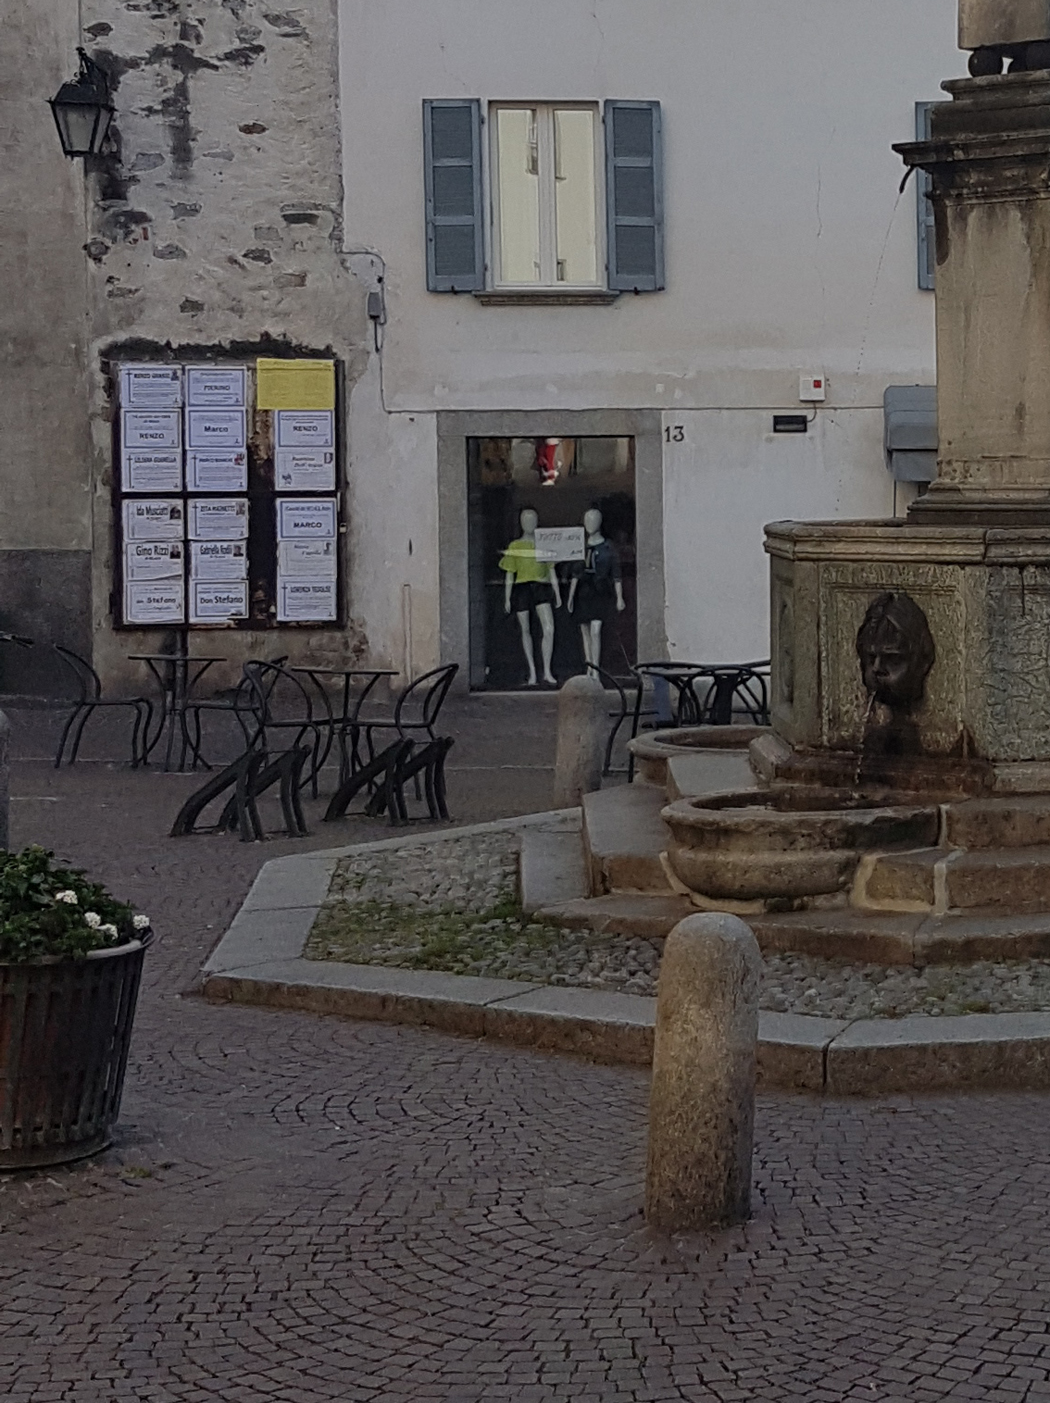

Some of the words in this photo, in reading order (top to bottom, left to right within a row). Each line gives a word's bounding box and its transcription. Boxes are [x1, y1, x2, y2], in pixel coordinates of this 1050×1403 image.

[203, 425, 229, 433] Marco
[664, 425, 685, 443] 13
[136, 544, 152, 556] Gino
[147, 596, 176, 604] Stefano
[214, 594, 243, 604] Stefano
